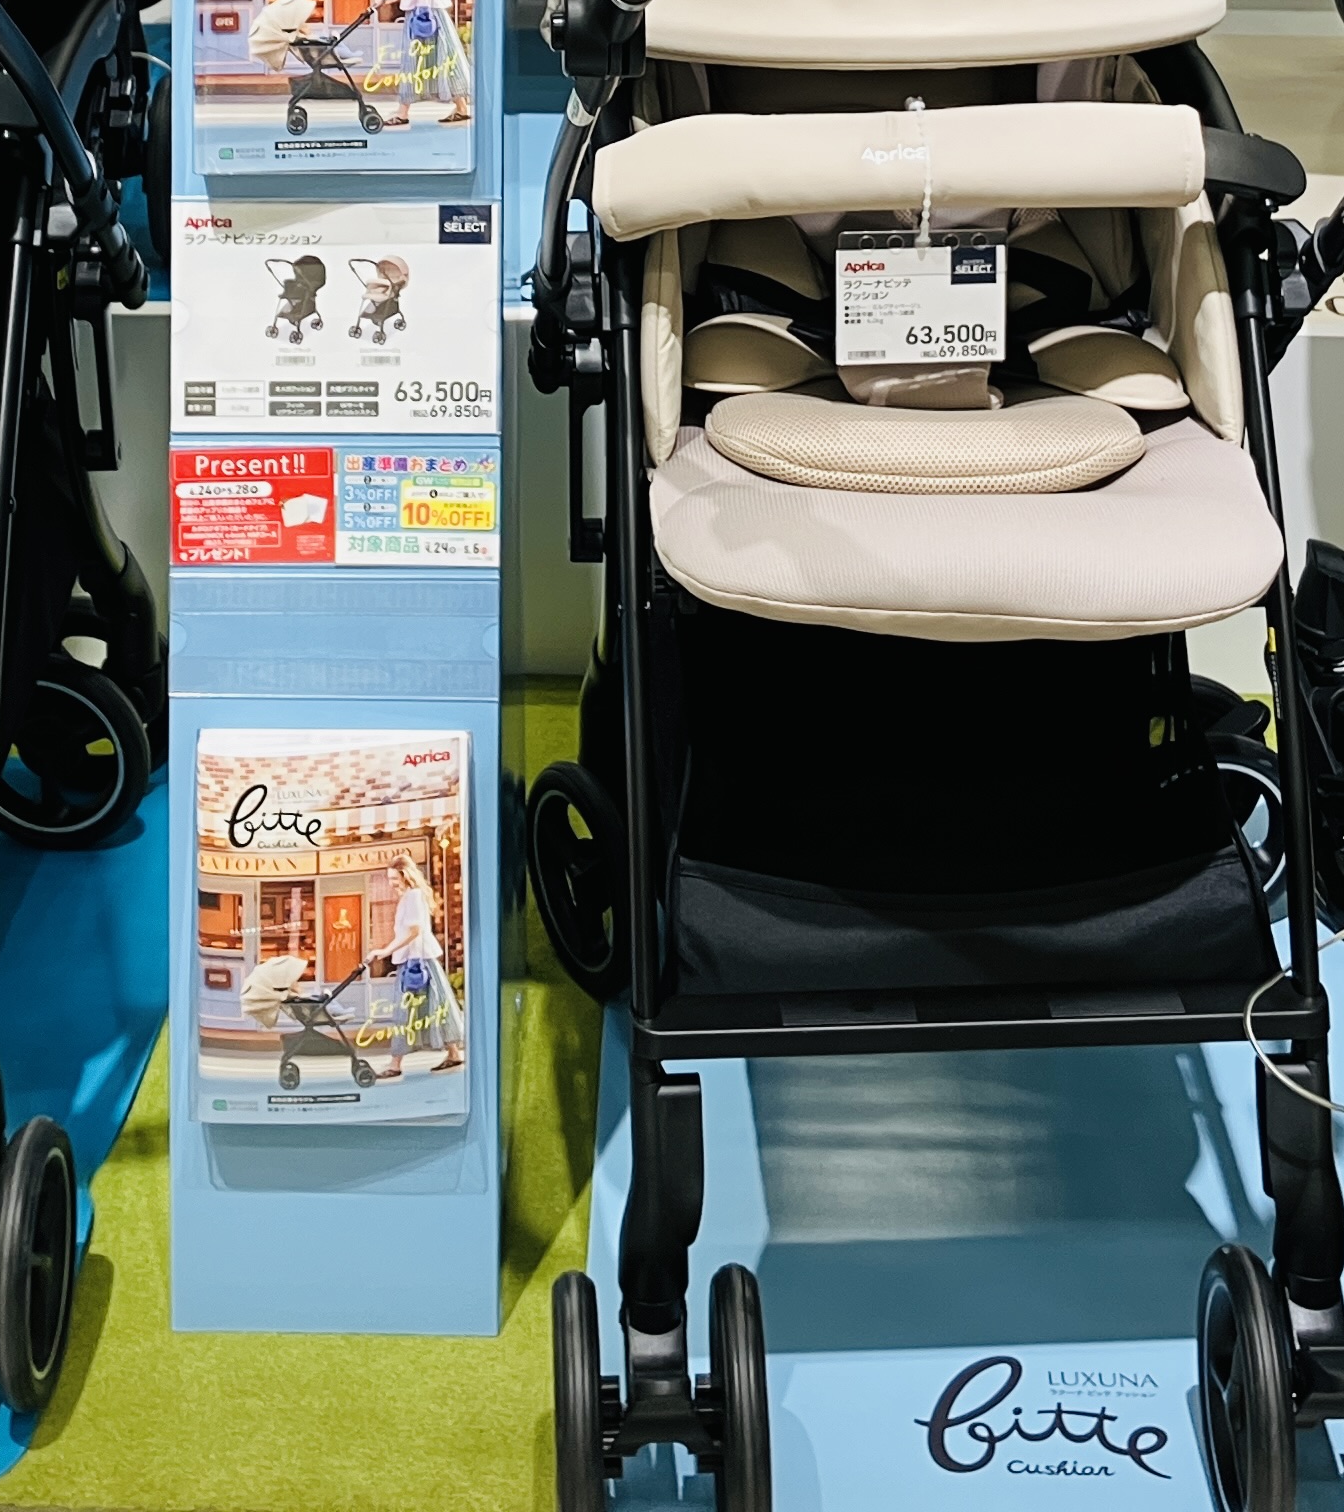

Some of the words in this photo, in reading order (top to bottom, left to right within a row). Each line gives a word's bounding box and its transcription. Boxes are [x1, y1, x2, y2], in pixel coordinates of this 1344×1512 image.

[184, 214, 233, 230] Aprica
[442, 221, 487, 234] SELECT
[843, 260, 886, 274] Aprica
[954, 263, 994, 274] SELECT
[905, 323, 997, 346] 63,500円
[393, 380, 492, 403] 63,500円
[194, 453, 306, 477] Present!!
[344, 514, 398, 529] 5%OFF!
[402, 502, 492, 528] 10%OFF!
[347, 535, 421, 554] 対象商品
[402, 748, 451, 768] Aprica
[1047, 1370, 1160, 1389] LUXUNA
[1006, 1459, 1116, 1477] Cushion
